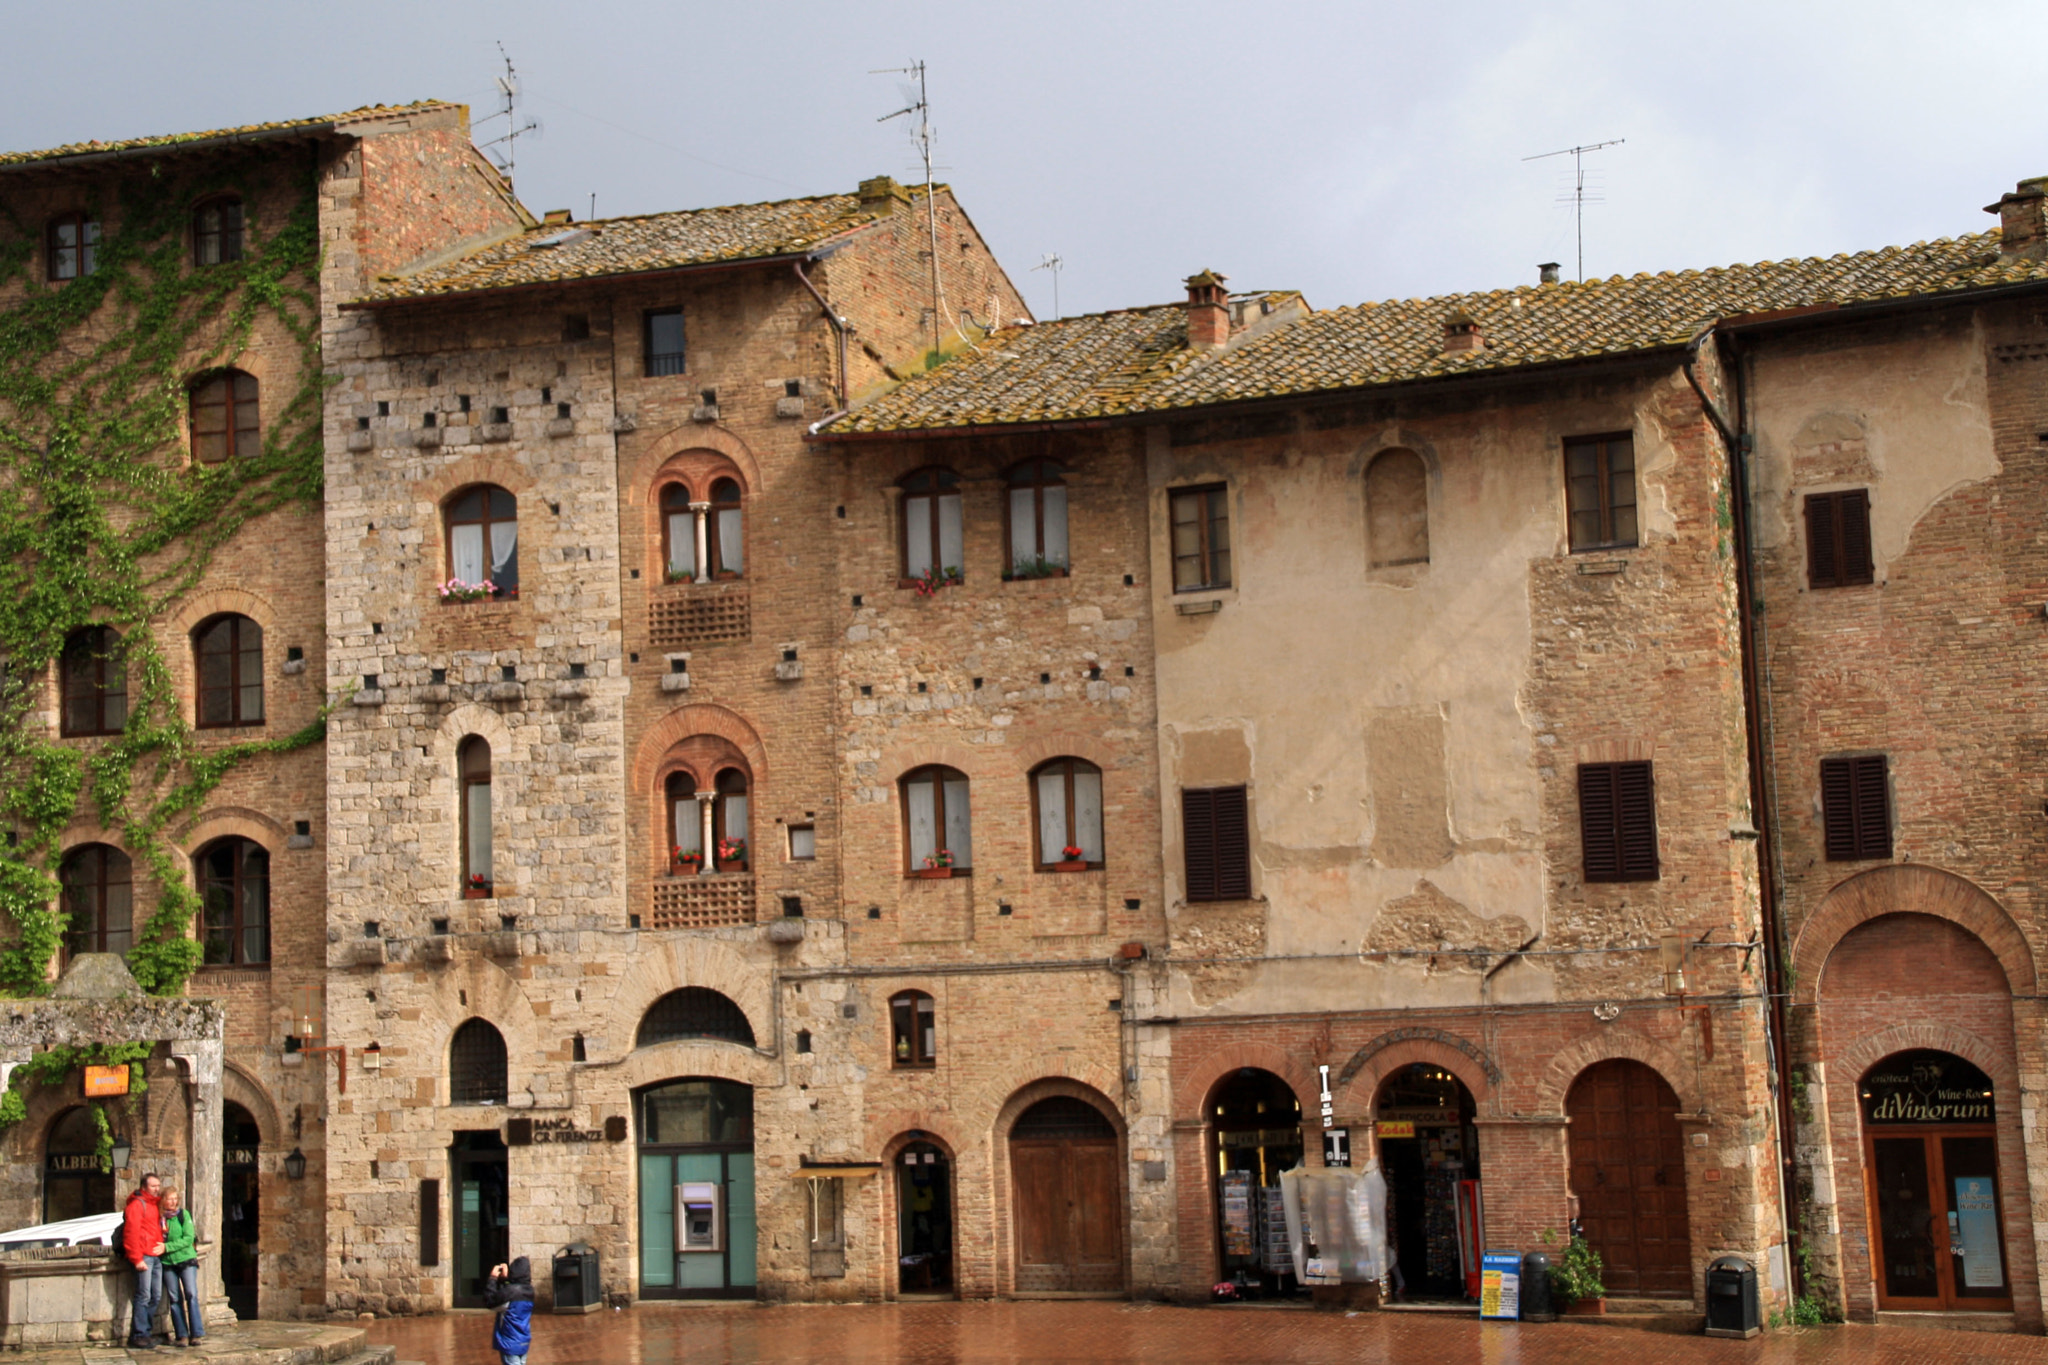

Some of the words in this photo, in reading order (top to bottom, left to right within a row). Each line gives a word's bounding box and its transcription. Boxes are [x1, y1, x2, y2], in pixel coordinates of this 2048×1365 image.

[1873, 1092, 1989, 1119] diVinorum
[1399, 1111, 1446, 1121] EDICOLA
[534, 1119, 574, 1130] BANCA
[1377, 1123, 1414, 1135] Kodak
[534, 1132, 552, 1143] CR
[556, 1130, 602, 1142] FIRENZE
[52, 1155, 104, 1170] ALBER
